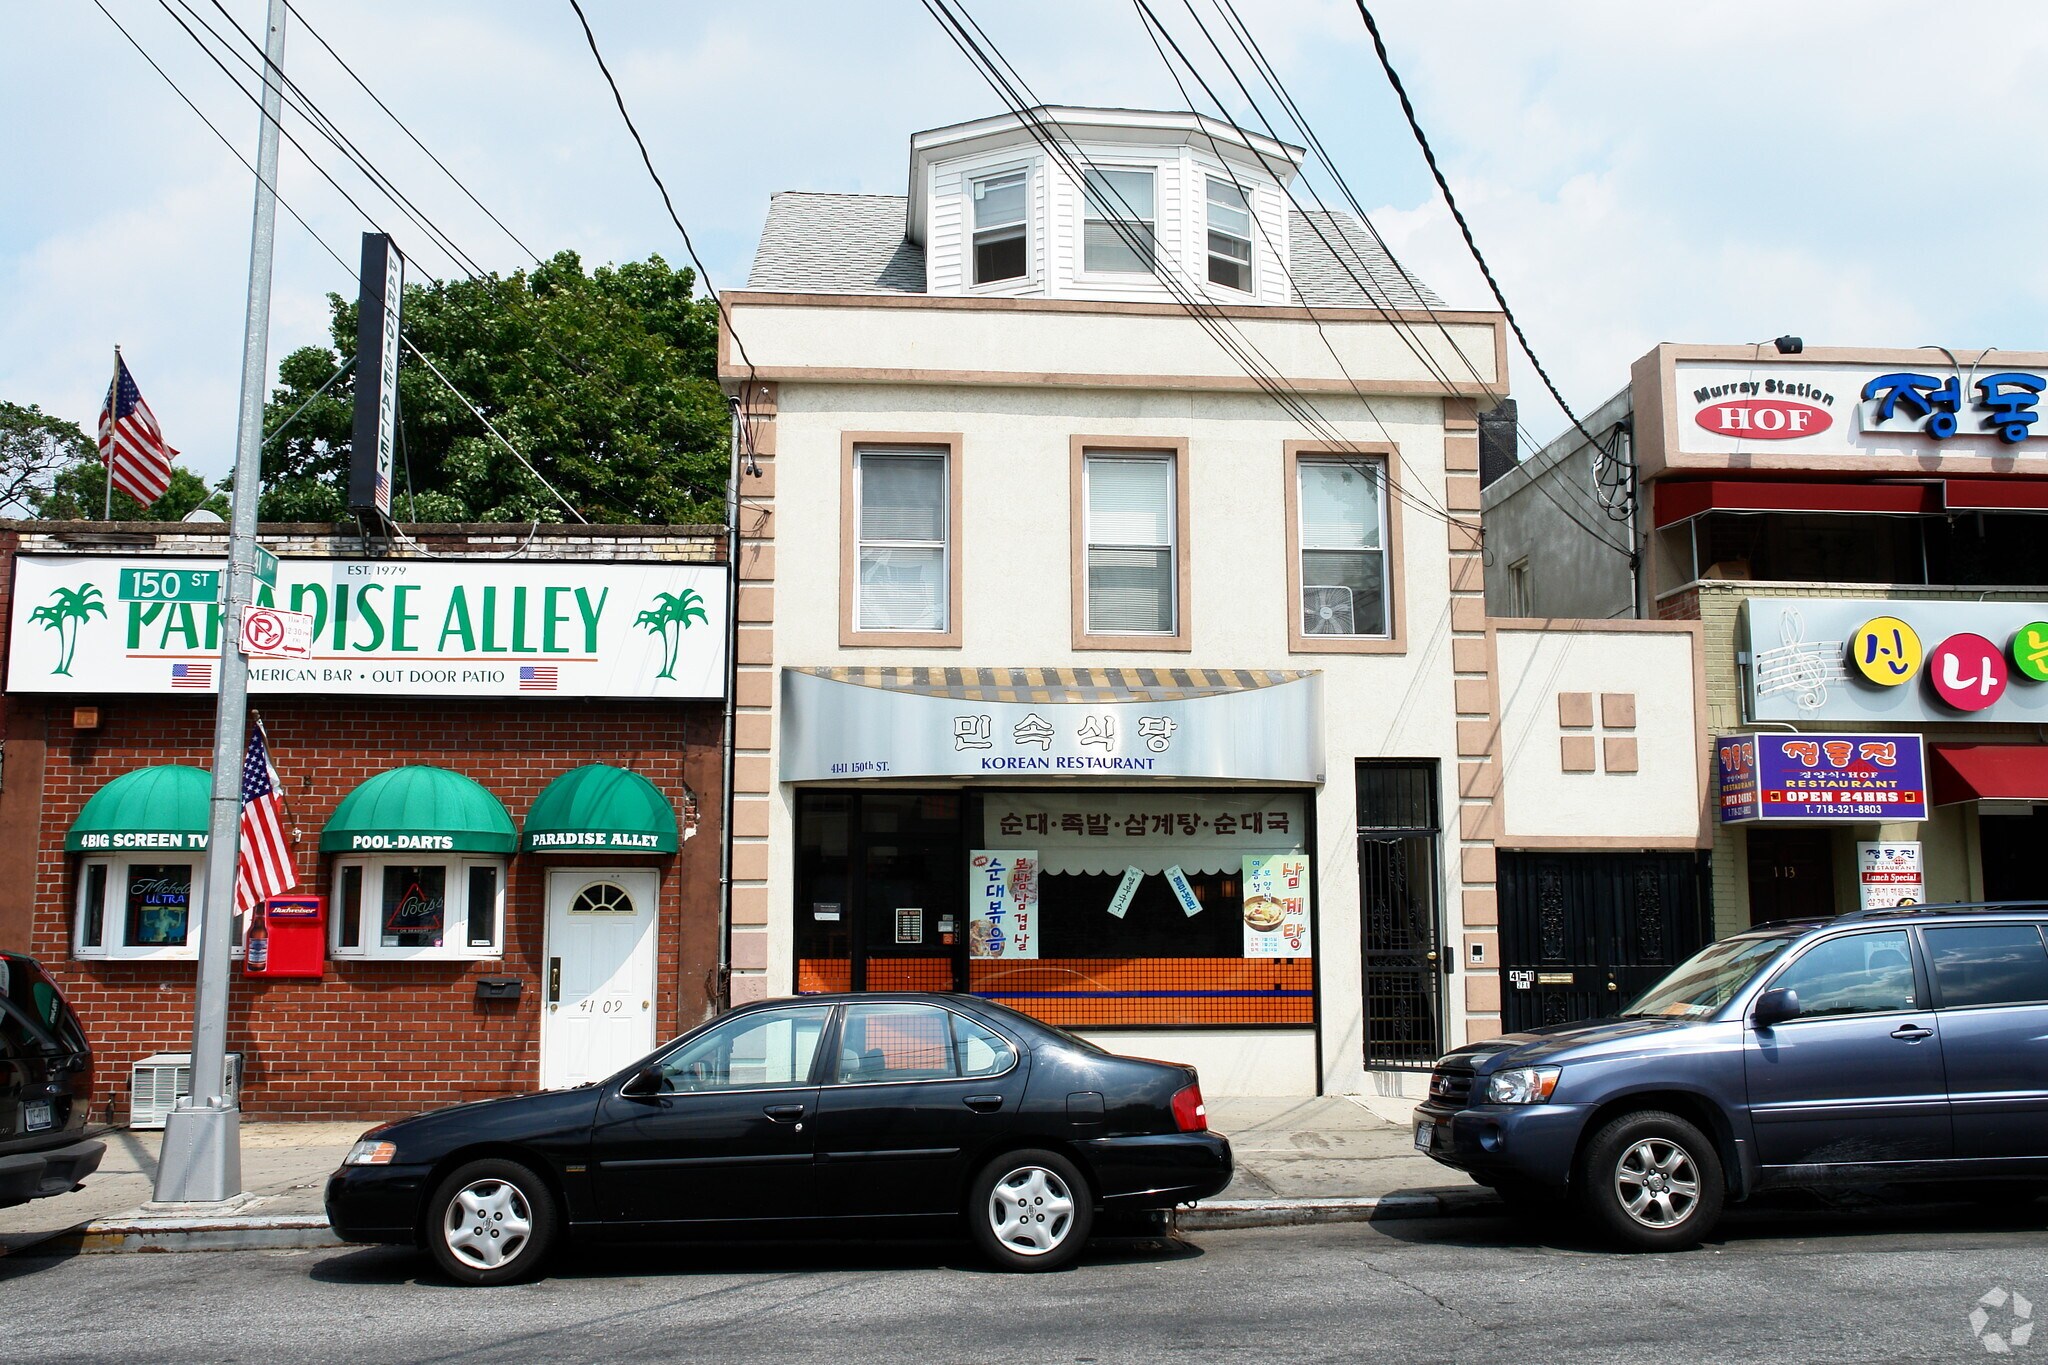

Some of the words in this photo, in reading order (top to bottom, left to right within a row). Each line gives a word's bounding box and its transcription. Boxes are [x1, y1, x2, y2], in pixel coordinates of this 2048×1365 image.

[384, 255, 399, 390] PARADISE
[1694, 381, 1760, 404] Murray
[1765, 379, 1834, 406] Station
[1718, 407, 1812, 431] HOF
[379, 398, 392, 473] ALLEY
[348, 565, 371, 576] EST.
[376, 565, 407, 576] 1979
[132, 571, 181, 598] 150
[191, 573, 210, 587] ST
[437, 585, 609, 653] ALLEY
[247, 669, 317, 681] MERICAN
[323, 669, 352, 681] BAR
[372, 670, 404, 683] OUT
[410, 670, 457, 683] DOOR
[462, 670, 505, 683] PATIO
[953, 713, 1178, 752] 민속식당
[1782, 740, 1897, 768] 정동진
[830, 763, 848, 774] 41-11
[851, 761, 874, 774] 150th
[876, 761, 890, 772] ST.
[981, 756, 1050, 770] KOREAN
[1056, 756, 1155, 770] RESTAURANT
[1848, 771, 1879, 779] HOF
[1786, 780, 1898, 788] RESTAURANT
[1786, 791, 1833, 802] OPEN
[1840, 791, 1899, 803] 24HRS
[1805, 805, 1813, 814] T.
[1817, 804, 1882, 814] 718-321-8803
[81, 834, 110, 848] 4BIG
[113, 833, 182, 847] SCREEN
[352, 835, 453, 849] POOL-DARTS
[532, 833, 606, 846] PARADISE
[610, 833, 659, 847] ALLEY
[1866, 873, 1889, 882] Lunch
[1890, 873, 1917, 884] Special
[131, 878, 191, 895] Michelo
[146, 894, 185, 904] ULTRA
[985, 857, 1006, 951] 순대볶음
[401, 896, 444, 917] Bass
[1282, 862, 1306, 951] 삼계탕
[1512, 971, 1534, 981] 41-11
